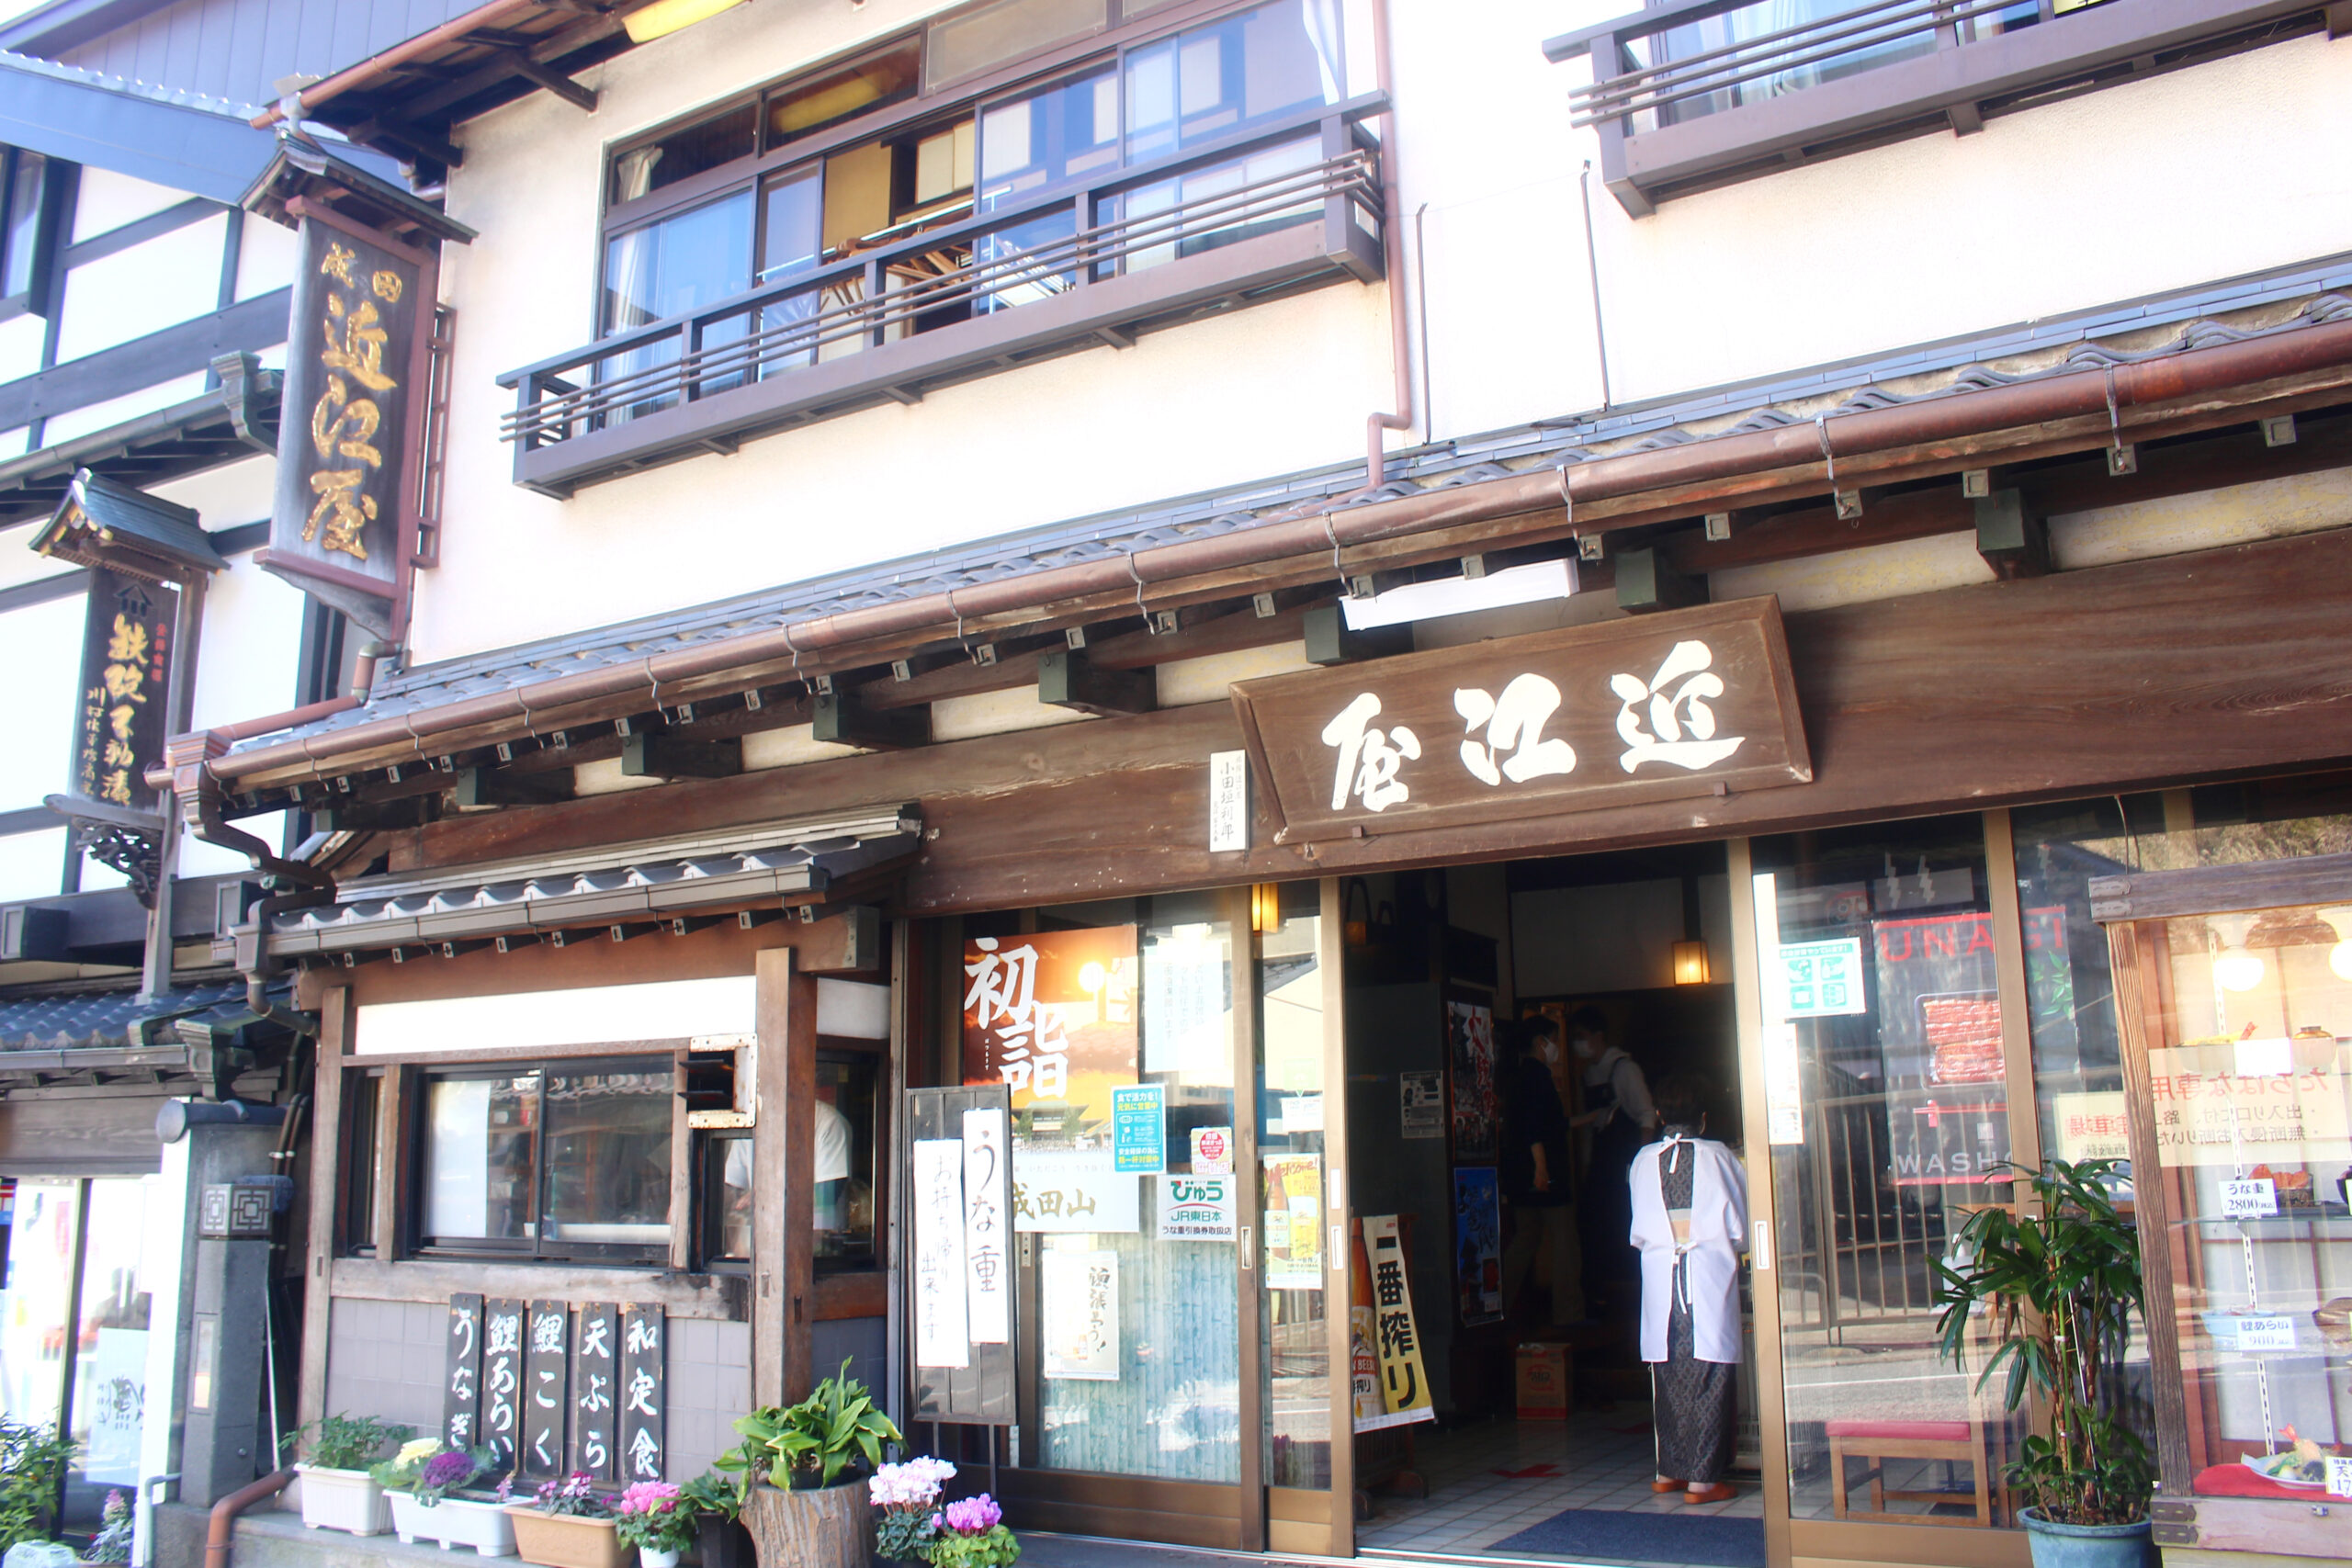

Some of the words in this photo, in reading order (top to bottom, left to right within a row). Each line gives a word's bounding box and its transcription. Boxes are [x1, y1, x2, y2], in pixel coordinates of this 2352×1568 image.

[321, 242, 402, 303] 成田
[301, 292, 397, 561] 近江屋
[1321, 640, 1746, 811] 近江屋
[965, 937, 1069, 1099] 初詣
[969, 1130, 1001, 1292] うな重
[1170, 1180, 1224, 1201] びゅう
[1170, 1211, 1223, 1223] JR東日本
[1897, 1149, 2013, 1174] WASH
[2227, 1182, 2264, 1195] うな重
[450, 1307, 474, 1448] うなぎ
[486, 1314, 519, 1463] 鯉あらい
[532, 1313, 564, 1466] 鯉こく
[580, 1318, 611, 1468] 天ぷら
[1376, 1235, 1416, 1409] 一番搾り
[627, 1318, 660, 1478] 和定食
